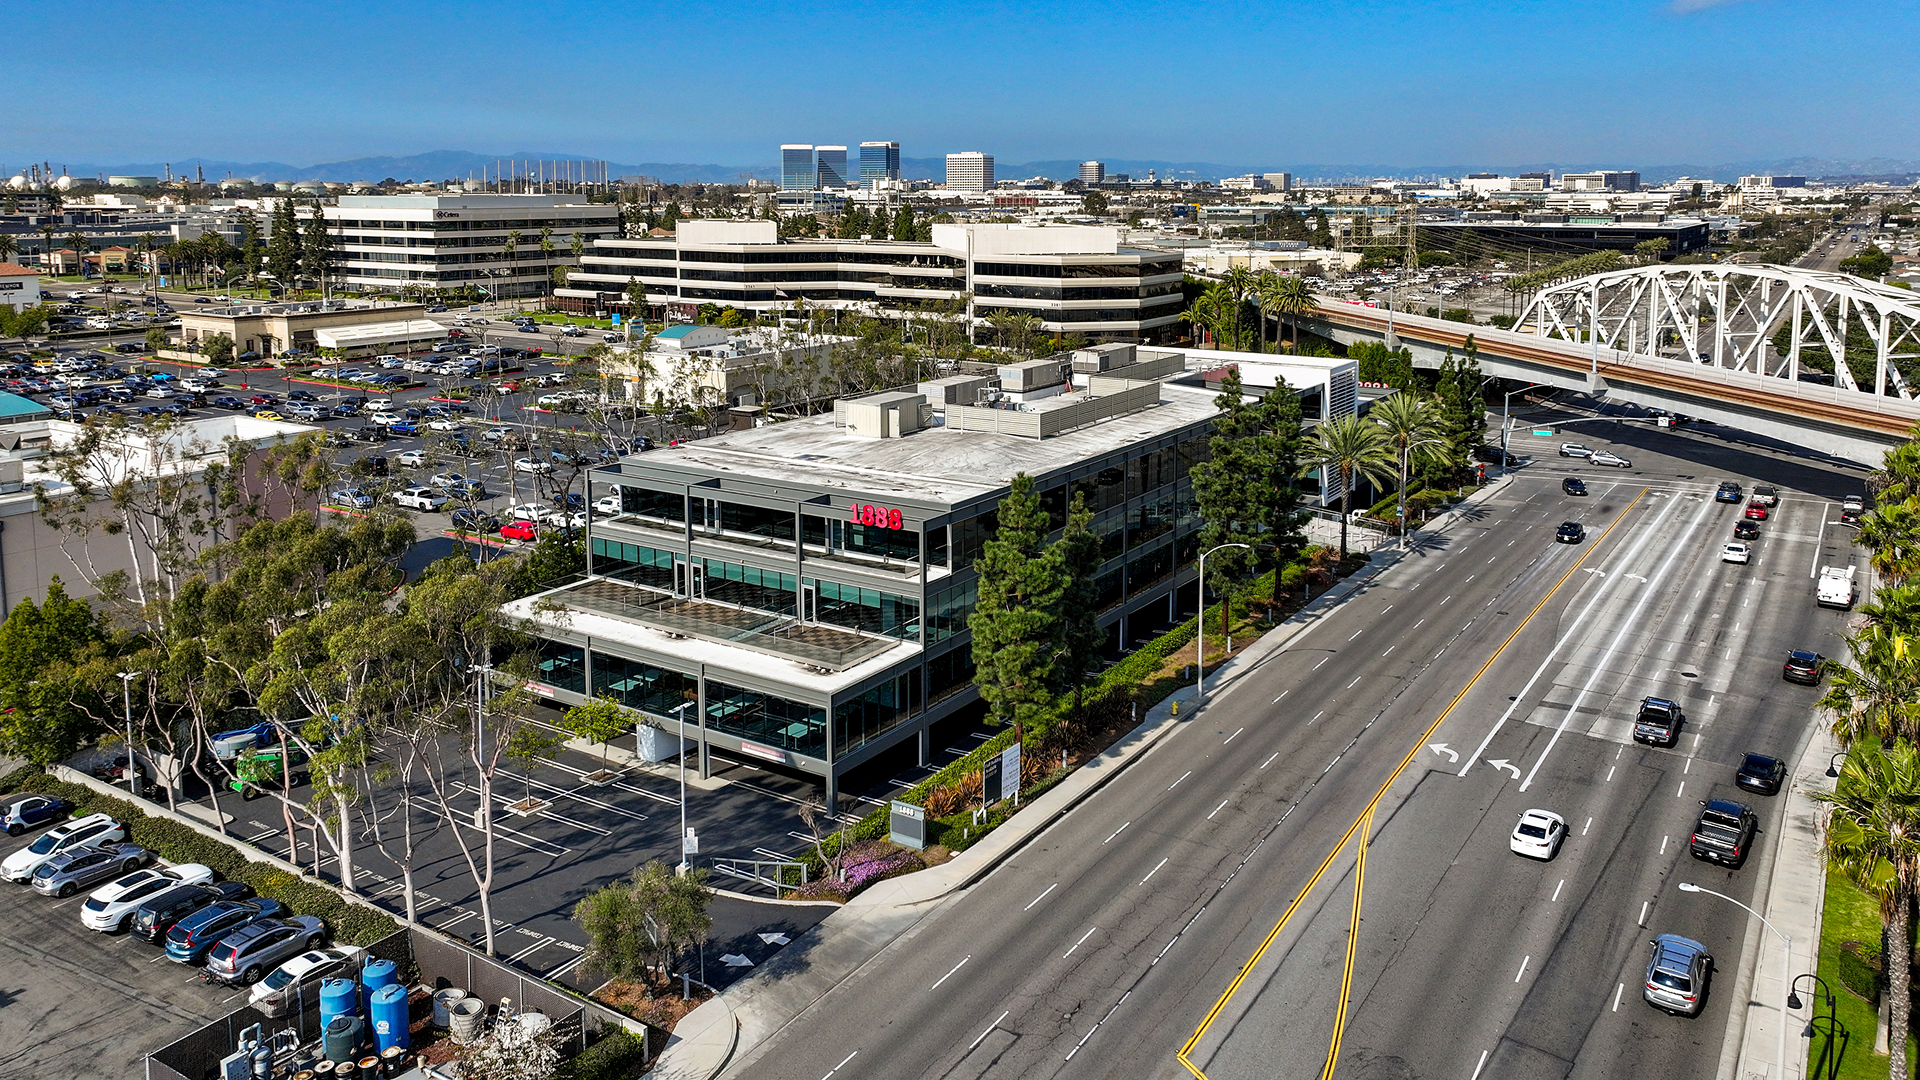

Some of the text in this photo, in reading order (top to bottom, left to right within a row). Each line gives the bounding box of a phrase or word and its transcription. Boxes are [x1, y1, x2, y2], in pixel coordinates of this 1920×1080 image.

[849, 503, 902, 531] 1888
[899, 806, 915, 817] 1888
[515, 928, 544, 939] COMPACT
[555, 941, 585, 952] COMPACT
